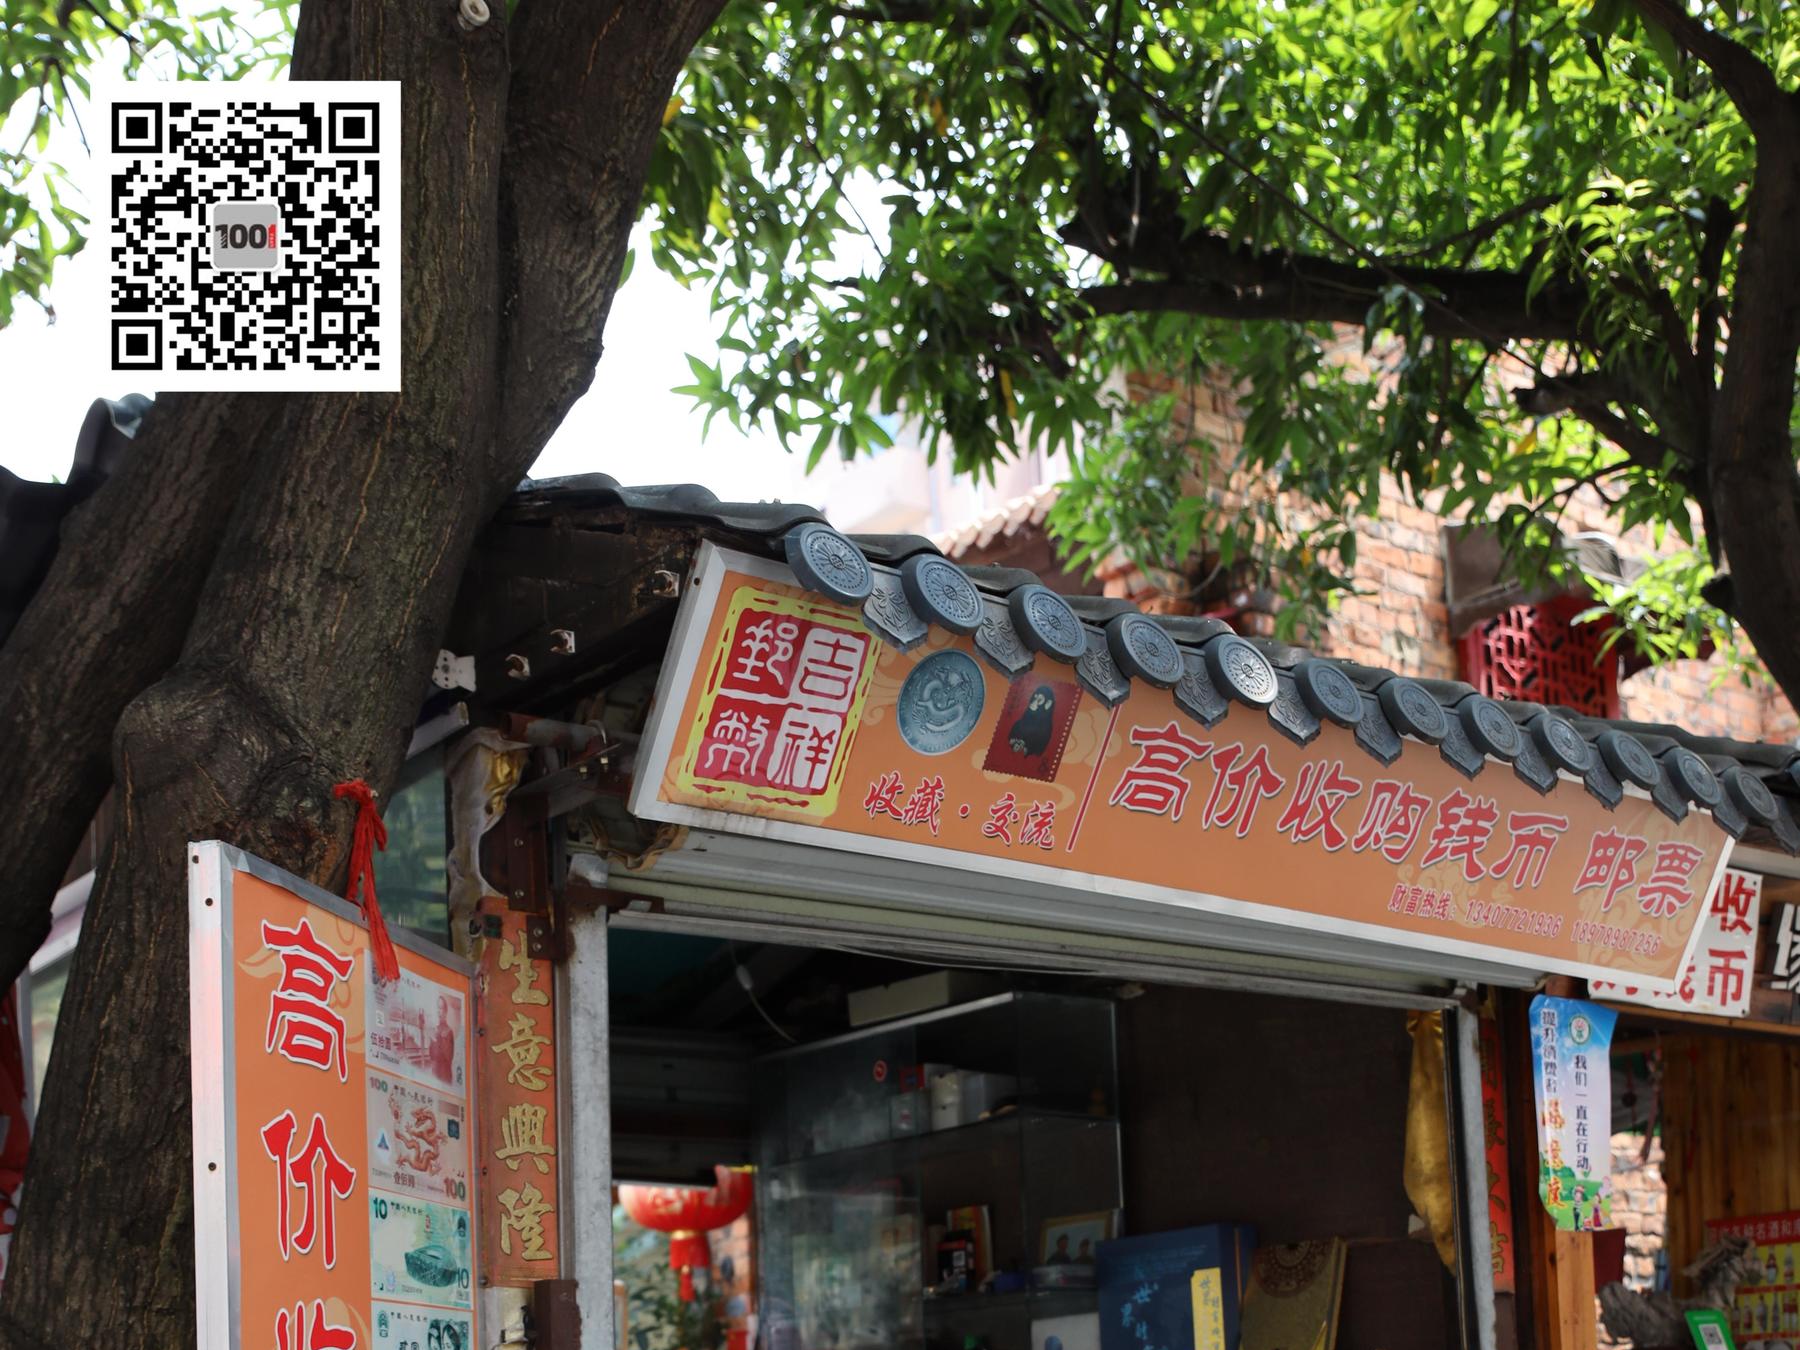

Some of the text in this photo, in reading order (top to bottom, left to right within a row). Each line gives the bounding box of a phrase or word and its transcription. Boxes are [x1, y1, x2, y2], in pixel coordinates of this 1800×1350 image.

[1110, 721, 1703, 919] 高价收购钱币 邮票
